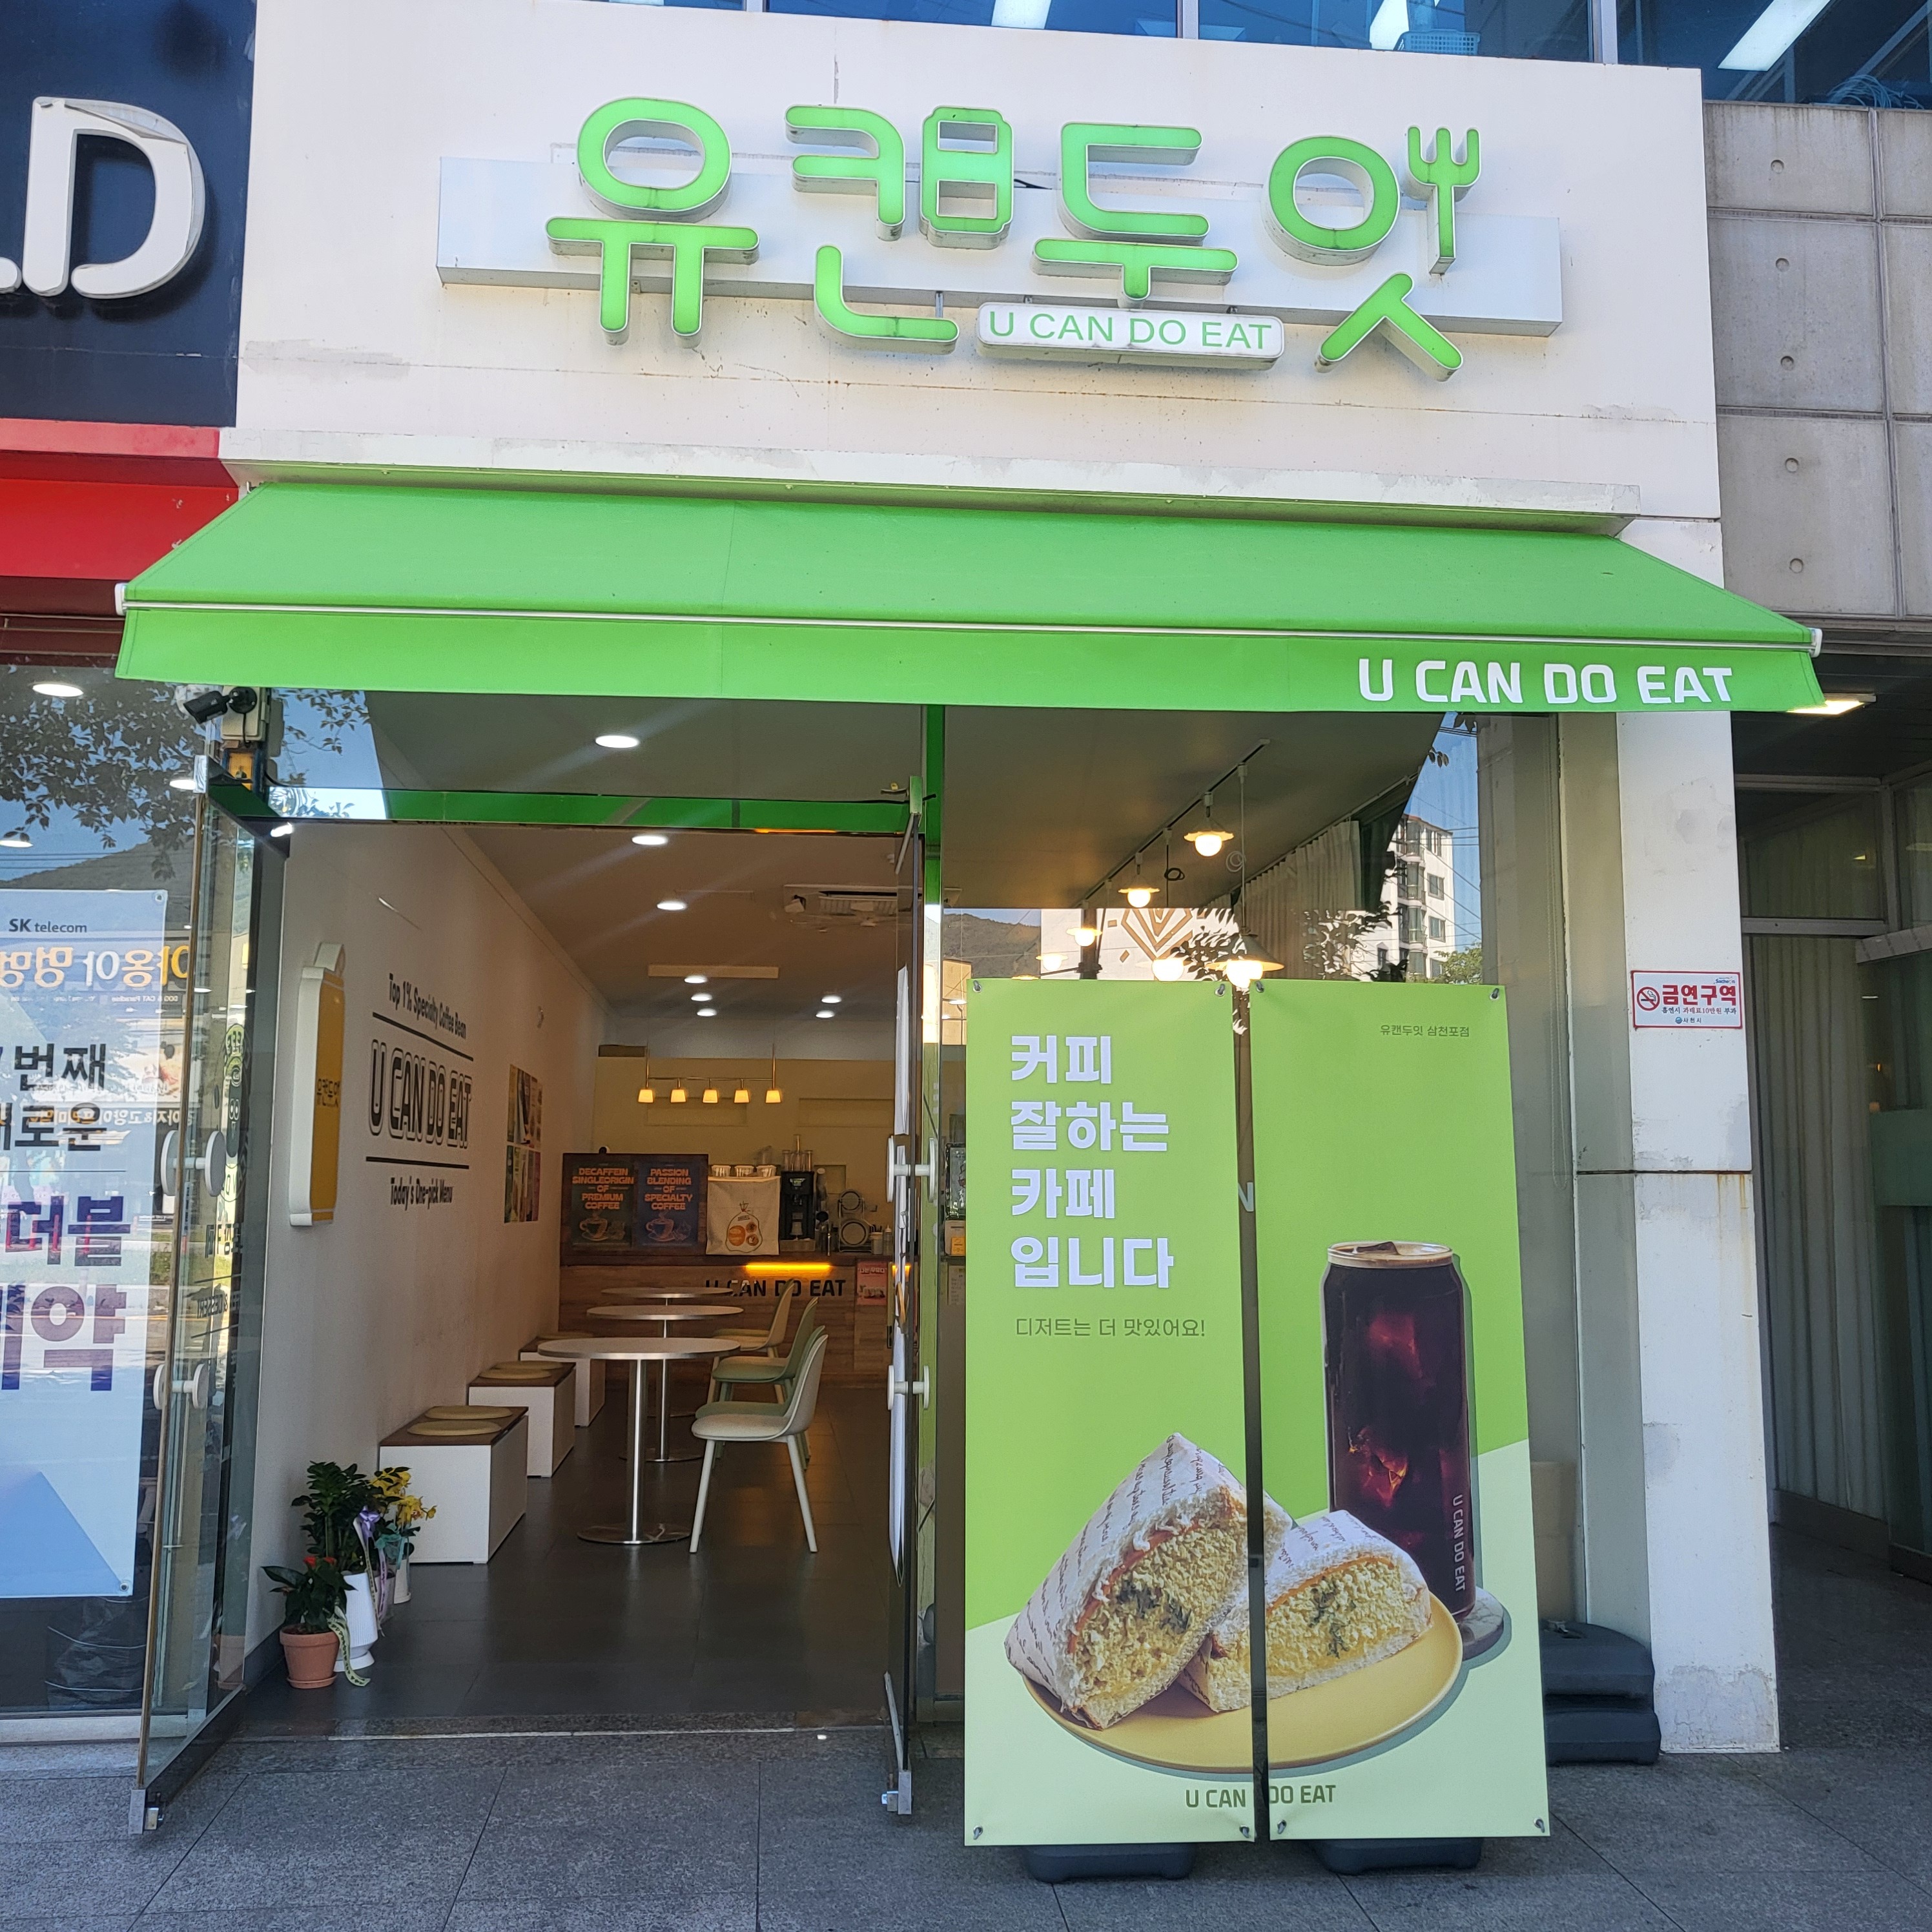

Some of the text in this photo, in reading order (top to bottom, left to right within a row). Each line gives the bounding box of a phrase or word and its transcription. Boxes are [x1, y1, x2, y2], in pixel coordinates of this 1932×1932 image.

[0, 96, 205, 300] D
[989, 311, 1272, 349] U CAN DO EAT
[1359, 658, 1733, 704] U CAN DO EAT
[8, 918, 87, 934] SK telecom
[389, 972, 400, 1011] Top
[1662, 984, 1736, 1006] 금연구역
[1380, 1025, 1470, 1037] 유캔두잇 삼천포점
[14, 1043, 107, 1091] 번째
[1011, 1035, 1111, 1084] 커피
[369, 1040, 472, 1148] U CAN DO EAT
[1011, 1101, 1169, 1152] 잘하는
[390, 1176, 414, 1211] Today's
[647, 1177, 692, 1185] BLENDING
[1011, 1168, 1115, 1219] 카페
[1011, 1237, 1174, 1289] 입니다
[810, 1280, 845, 1296] EAT
[1016, 1318, 1205, 1337] 디저트는 더 맛있어요!
[1453, 1495, 1465, 1592] U CAN DO EAT
[1186, 1789, 1199, 1807] U
[1206, 1789, 1246, 1808] CAN
[1300, 1785, 1336, 1804] EAT
